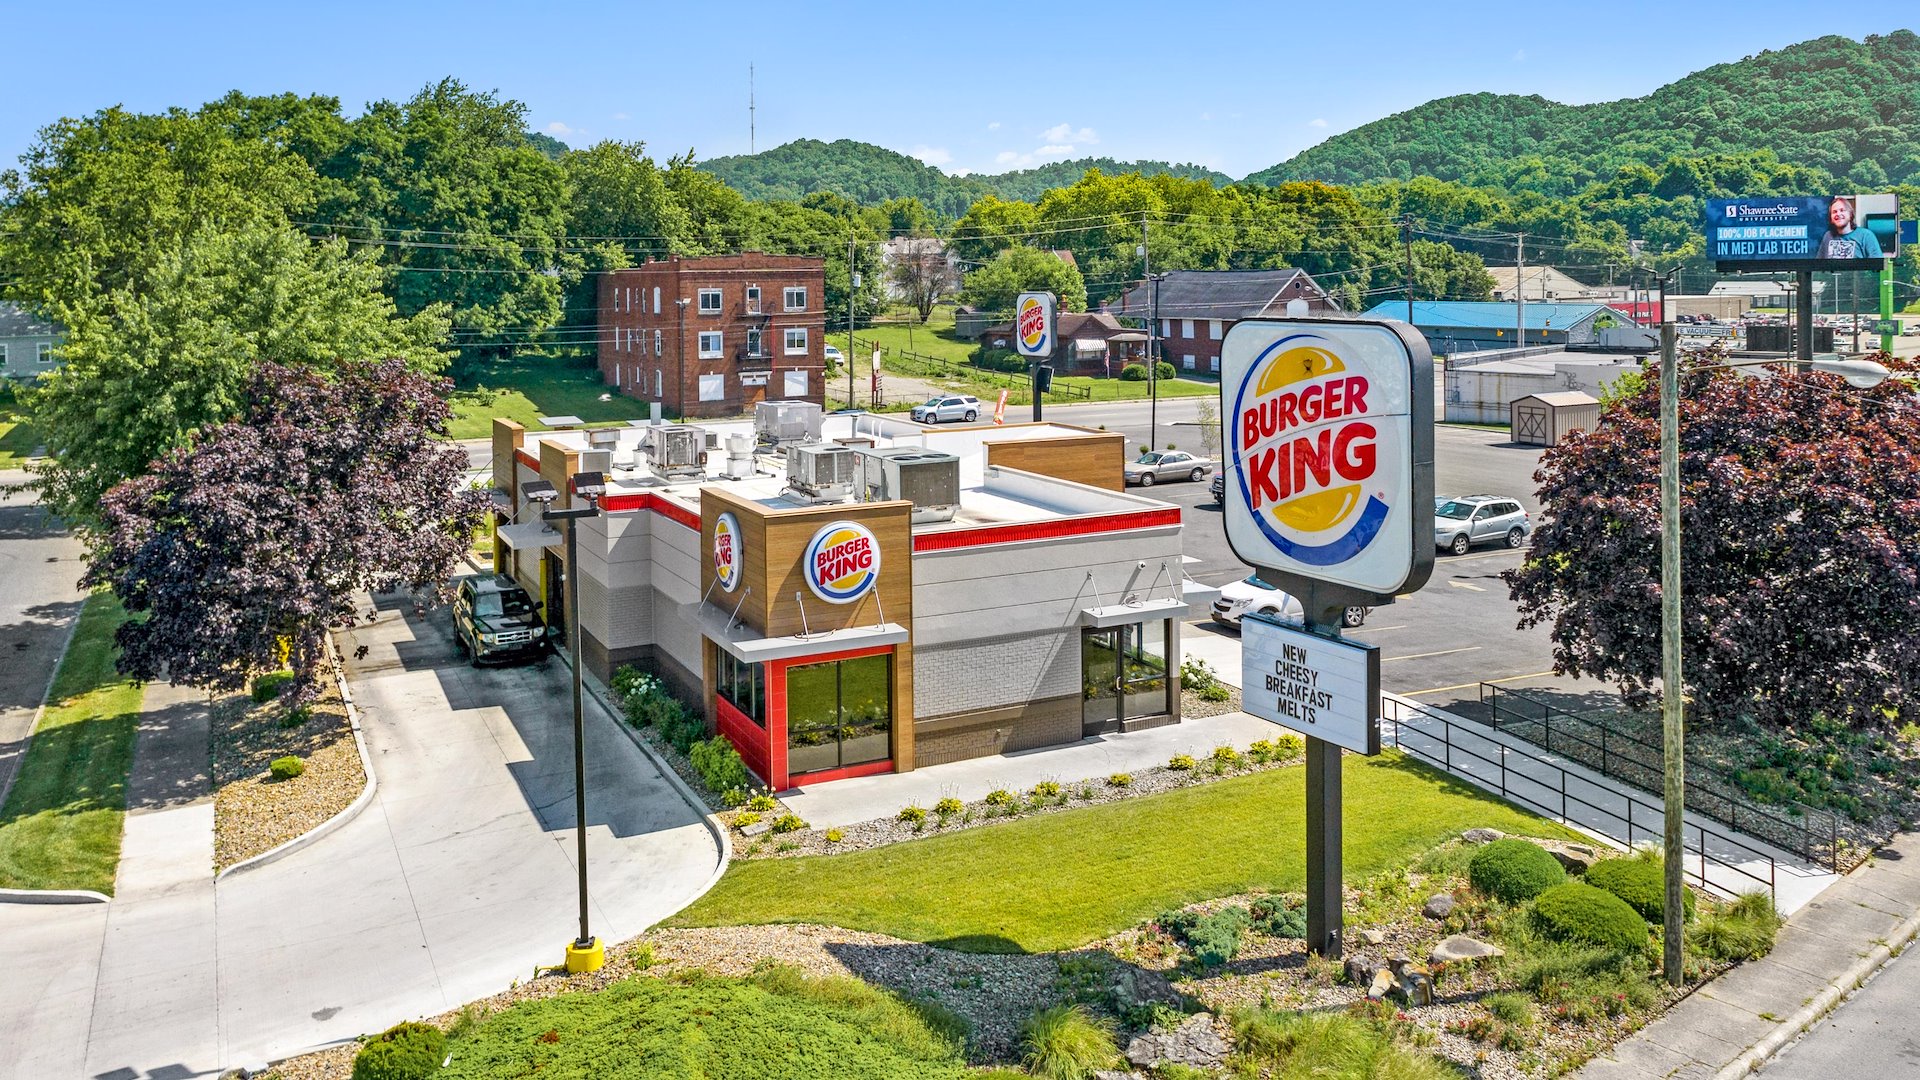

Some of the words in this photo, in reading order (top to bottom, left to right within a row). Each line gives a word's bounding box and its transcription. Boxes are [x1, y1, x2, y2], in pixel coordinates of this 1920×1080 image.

[1739, 205, 1776, 215] Shawnee
[1777, 203, 1798, 214] State
[1719, 228, 1742, 239] 100%
[1743, 227, 1757, 238] JOB
[1759, 226, 1806, 238] PLACEMENT
[1717, 242, 1728, 255] IN
[1731, 241, 1755, 255] MED
[1758, 241, 1778, 254] LAB
[1781, 240, 1808, 254] TECH
[1020, 306, 1043, 325] BURGER
[1020, 316, 1044, 341] KING
[1243, 375, 1369, 451] BURGER
[1249, 422, 1377, 510] KING
[817, 537, 870, 568] BURGER
[819, 549, 872, 586] KING
[1282, 643, 1307, 665] NEW
[1275, 659, 1318, 687] CHEESY
[1265, 674, 1333, 711] BREAKFAST
[1277, 697, 1316, 724] MELTS
